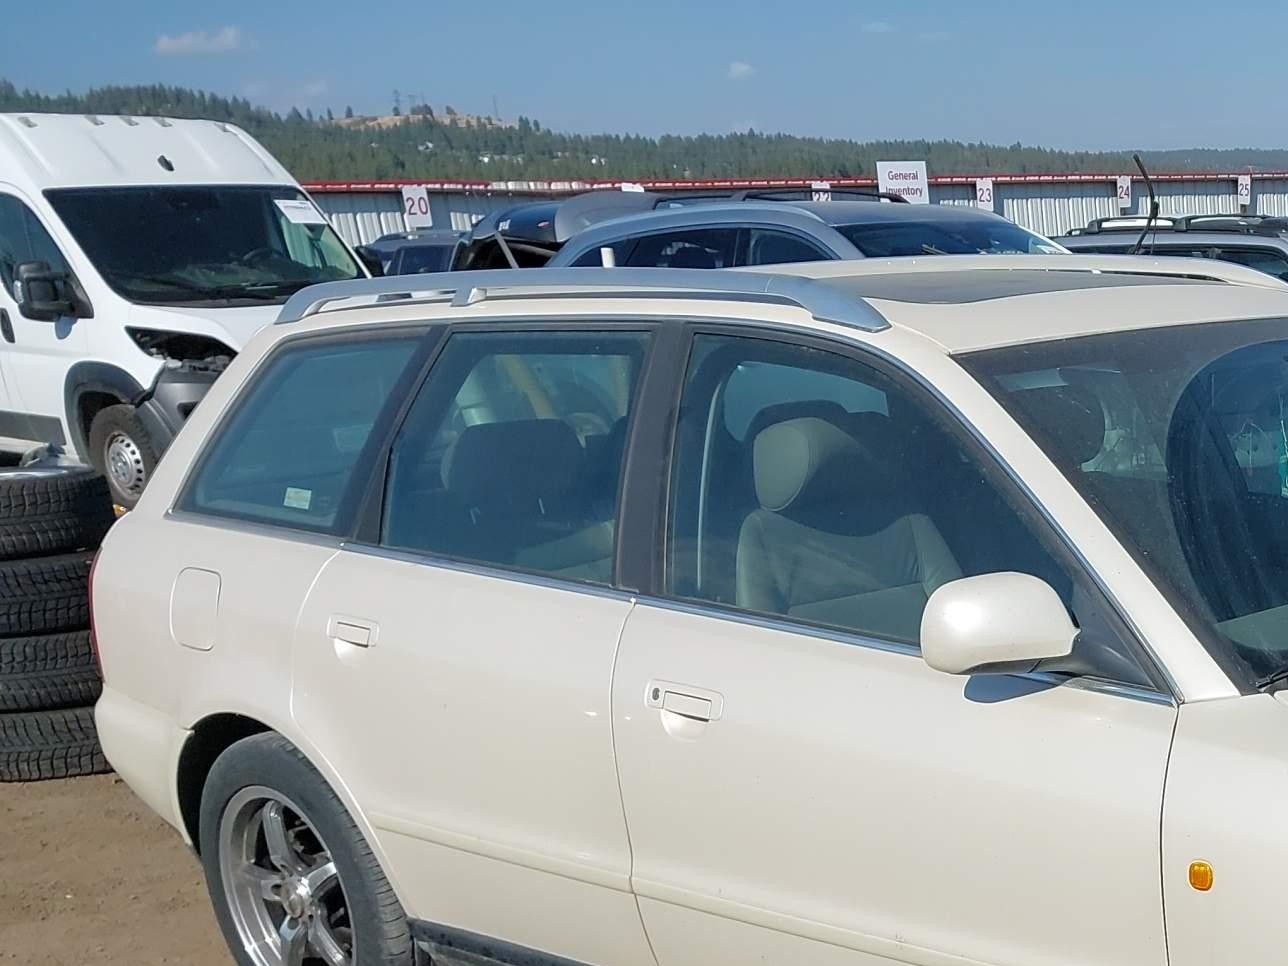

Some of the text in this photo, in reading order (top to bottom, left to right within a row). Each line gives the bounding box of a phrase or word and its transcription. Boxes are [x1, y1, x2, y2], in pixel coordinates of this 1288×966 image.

[887, 170, 919, 181] General
[885, 186, 923, 198] Inventory
[978, 187, 992, 203] 23
[1118, 185, 1130, 199] 24
[1239, 183, 1250, 196] 25
[406, 196, 429, 216] 20
